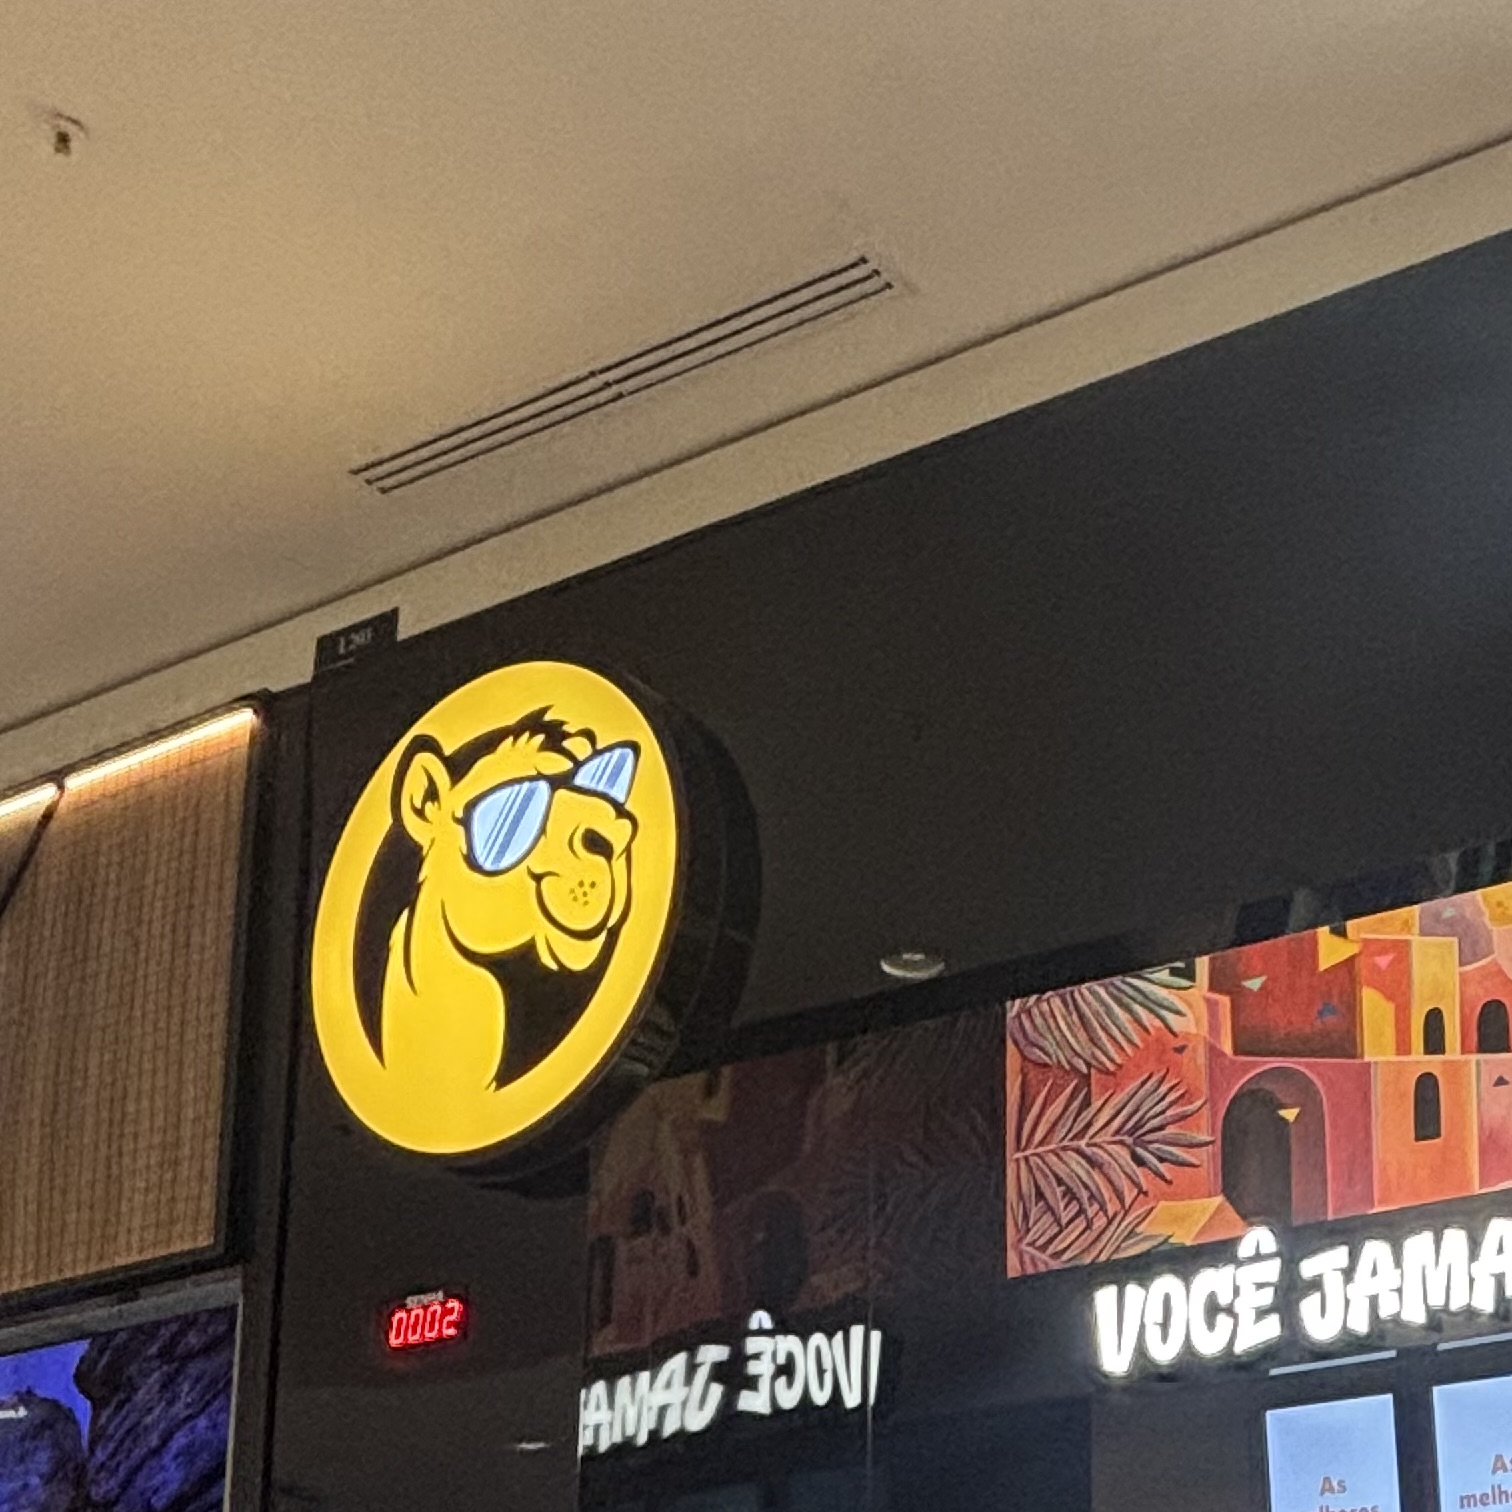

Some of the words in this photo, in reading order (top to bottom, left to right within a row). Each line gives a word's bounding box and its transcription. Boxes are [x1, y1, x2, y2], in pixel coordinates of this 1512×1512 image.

[388, 1298, 463, 1347] 0002
[1094, 1226, 1282, 1375] VOCÊ
[1320, 1477, 1346, 1496] As
